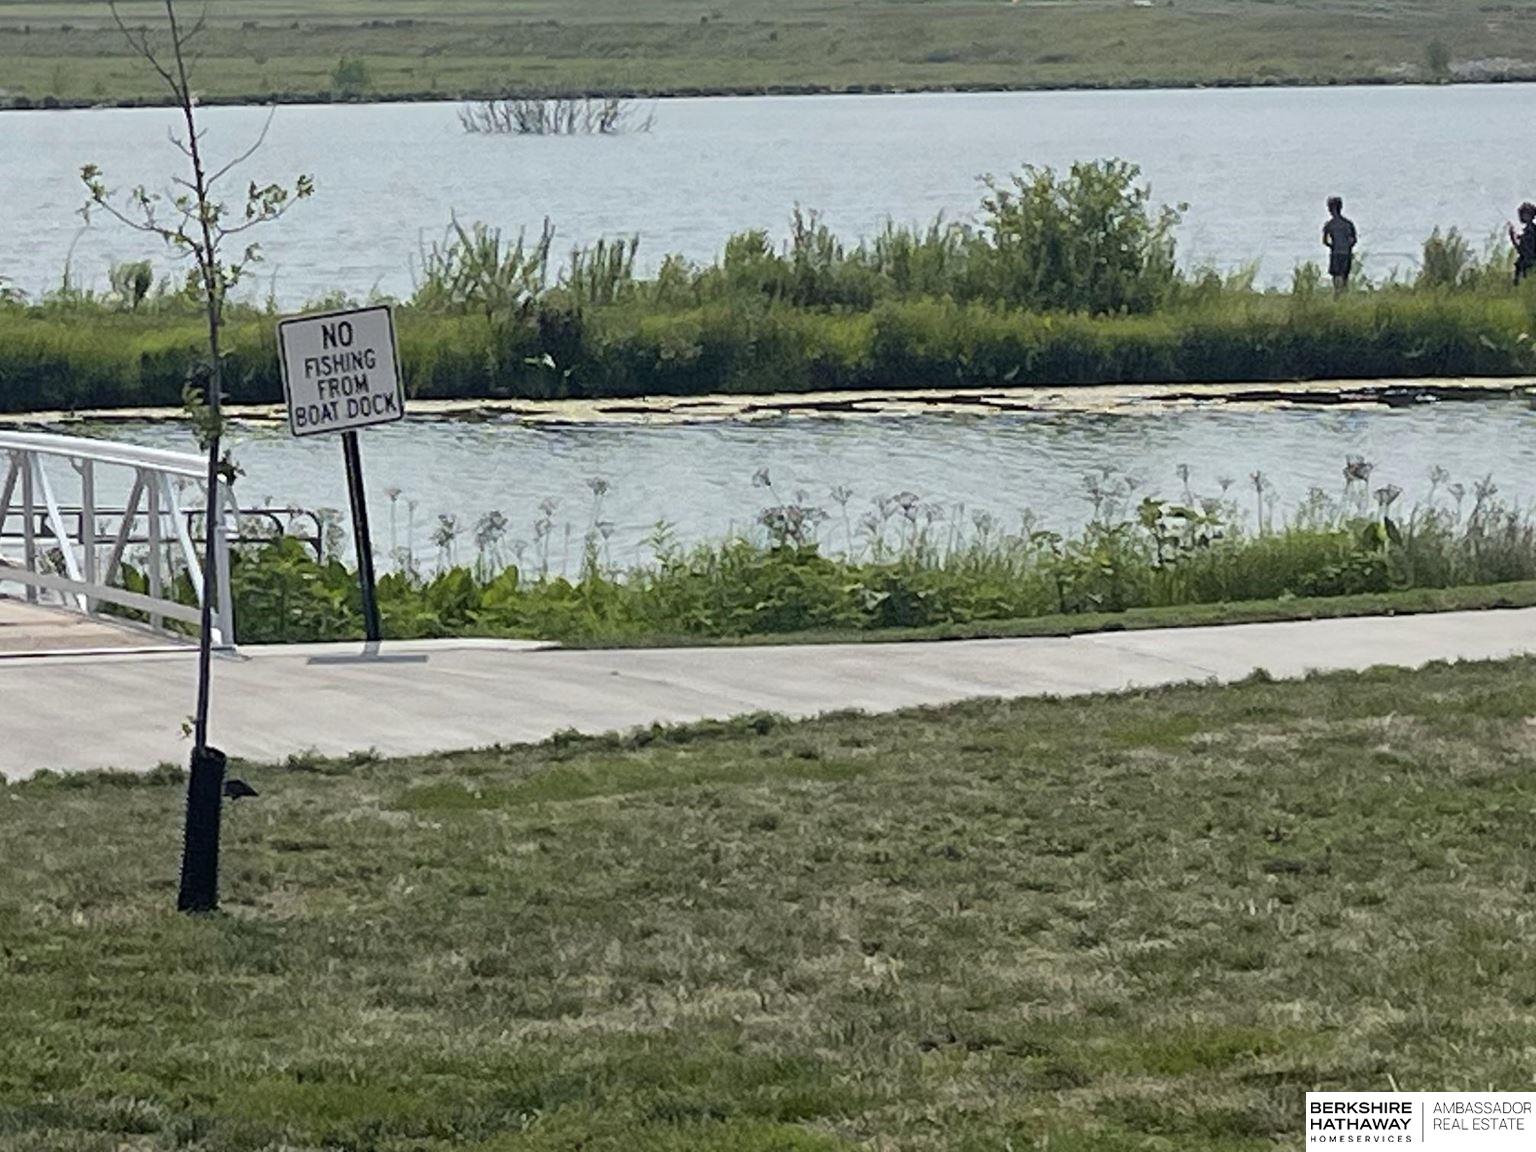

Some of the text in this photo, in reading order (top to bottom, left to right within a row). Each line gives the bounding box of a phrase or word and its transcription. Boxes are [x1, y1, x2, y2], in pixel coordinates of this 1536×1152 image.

[321, 321, 353, 349] NO
[304, 349, 376, 379] FISHING
[317, 374, 370, 400] FROM
[295, 391, 397, 427] BOAT DOCK
